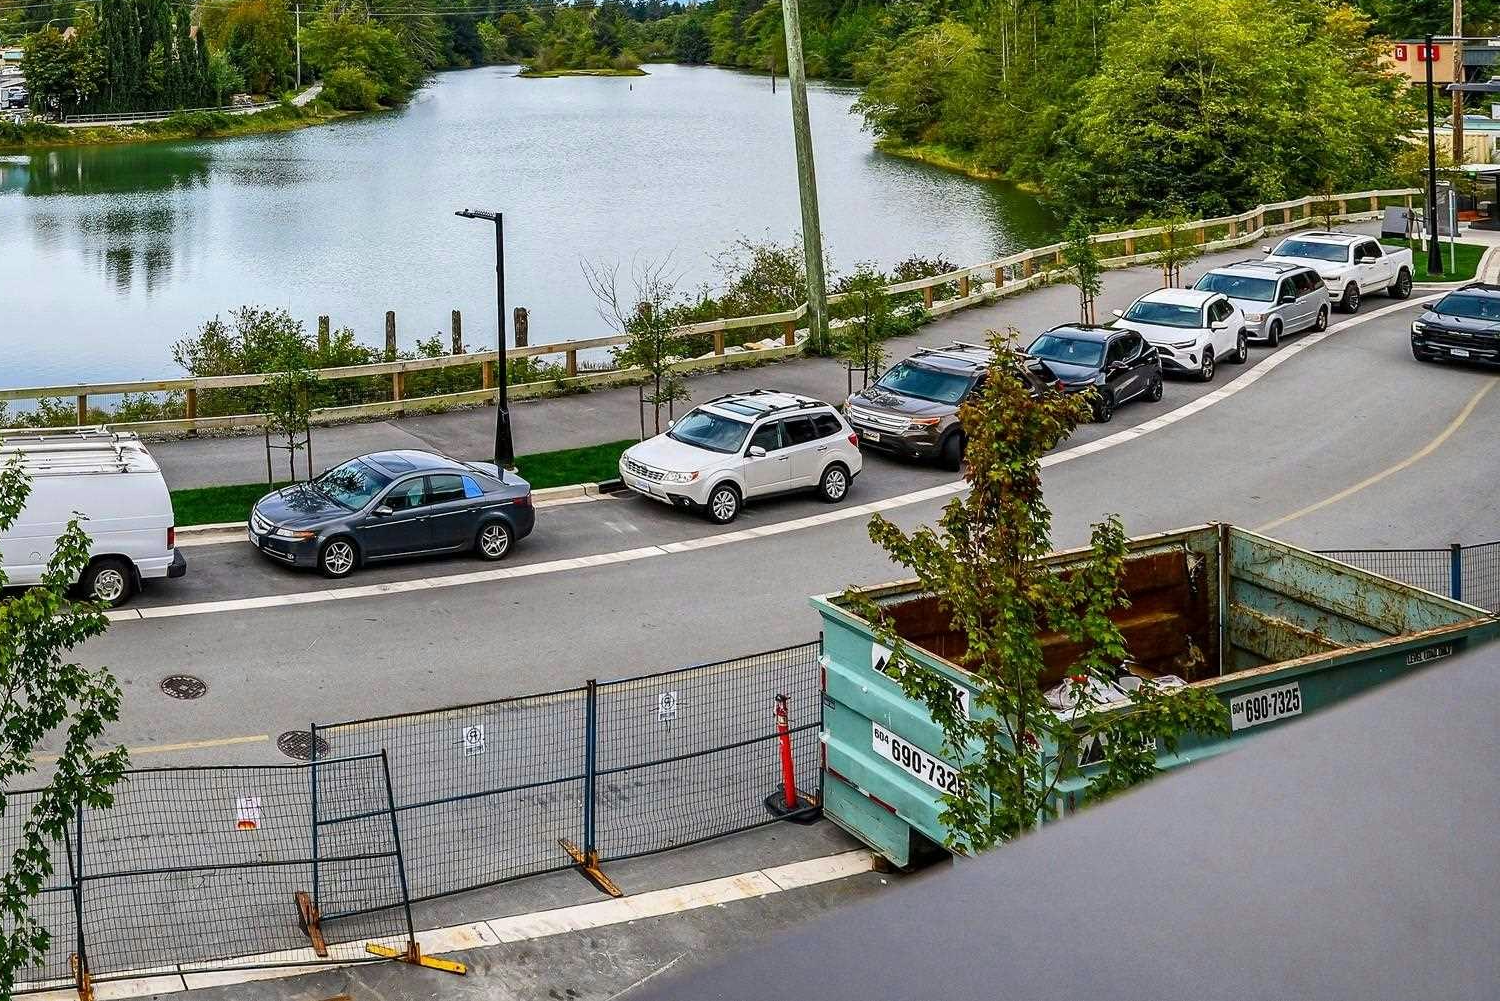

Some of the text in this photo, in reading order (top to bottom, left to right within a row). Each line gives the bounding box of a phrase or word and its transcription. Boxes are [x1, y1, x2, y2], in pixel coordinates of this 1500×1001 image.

[1232, 687, 1300, 722] 604 690-7325
[874, 728, 889, 745] 604
